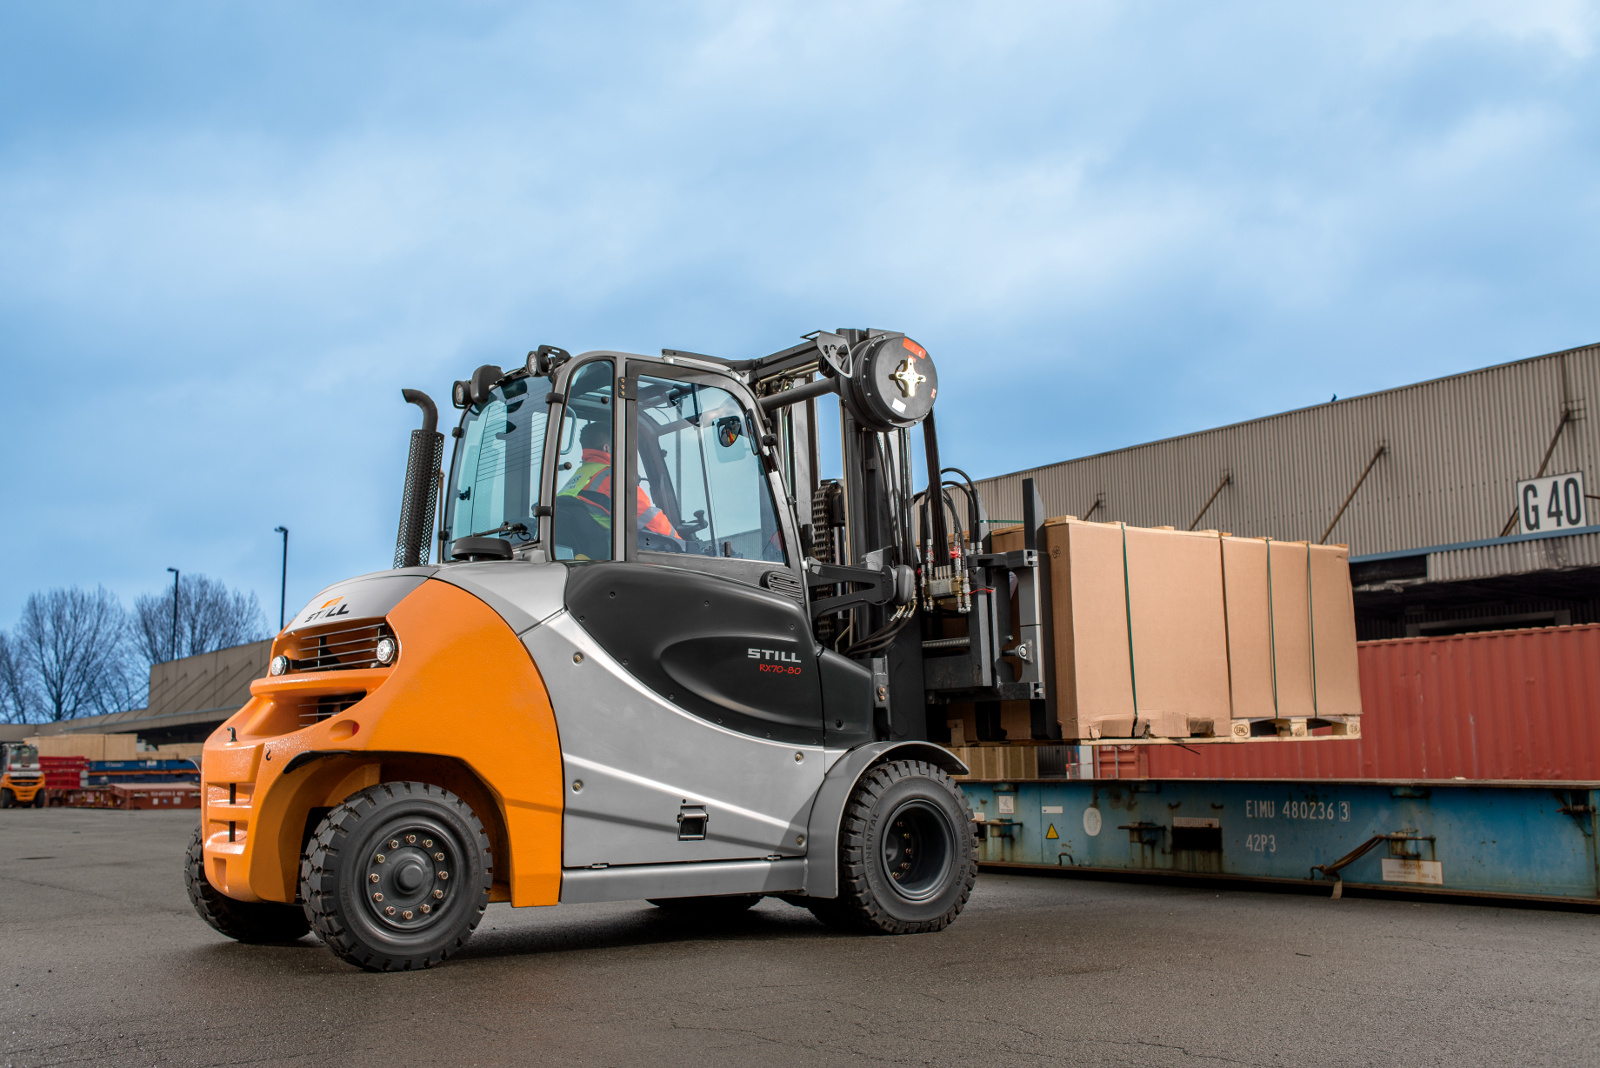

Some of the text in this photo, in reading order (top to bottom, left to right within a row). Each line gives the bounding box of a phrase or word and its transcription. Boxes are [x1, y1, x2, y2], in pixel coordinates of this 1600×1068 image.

[1523, 477, 1582, 531] G 40
[304, 603, 350, 623] STILL
[747, 648, 802, 663] STILL
[759, 663, 802, 675] RX70-80
[1245, 799, 1349, 821] EIMU 480236 3
[1245, 833, 1276, 853] 42P3
[954, 864, 967, 887] SC20
